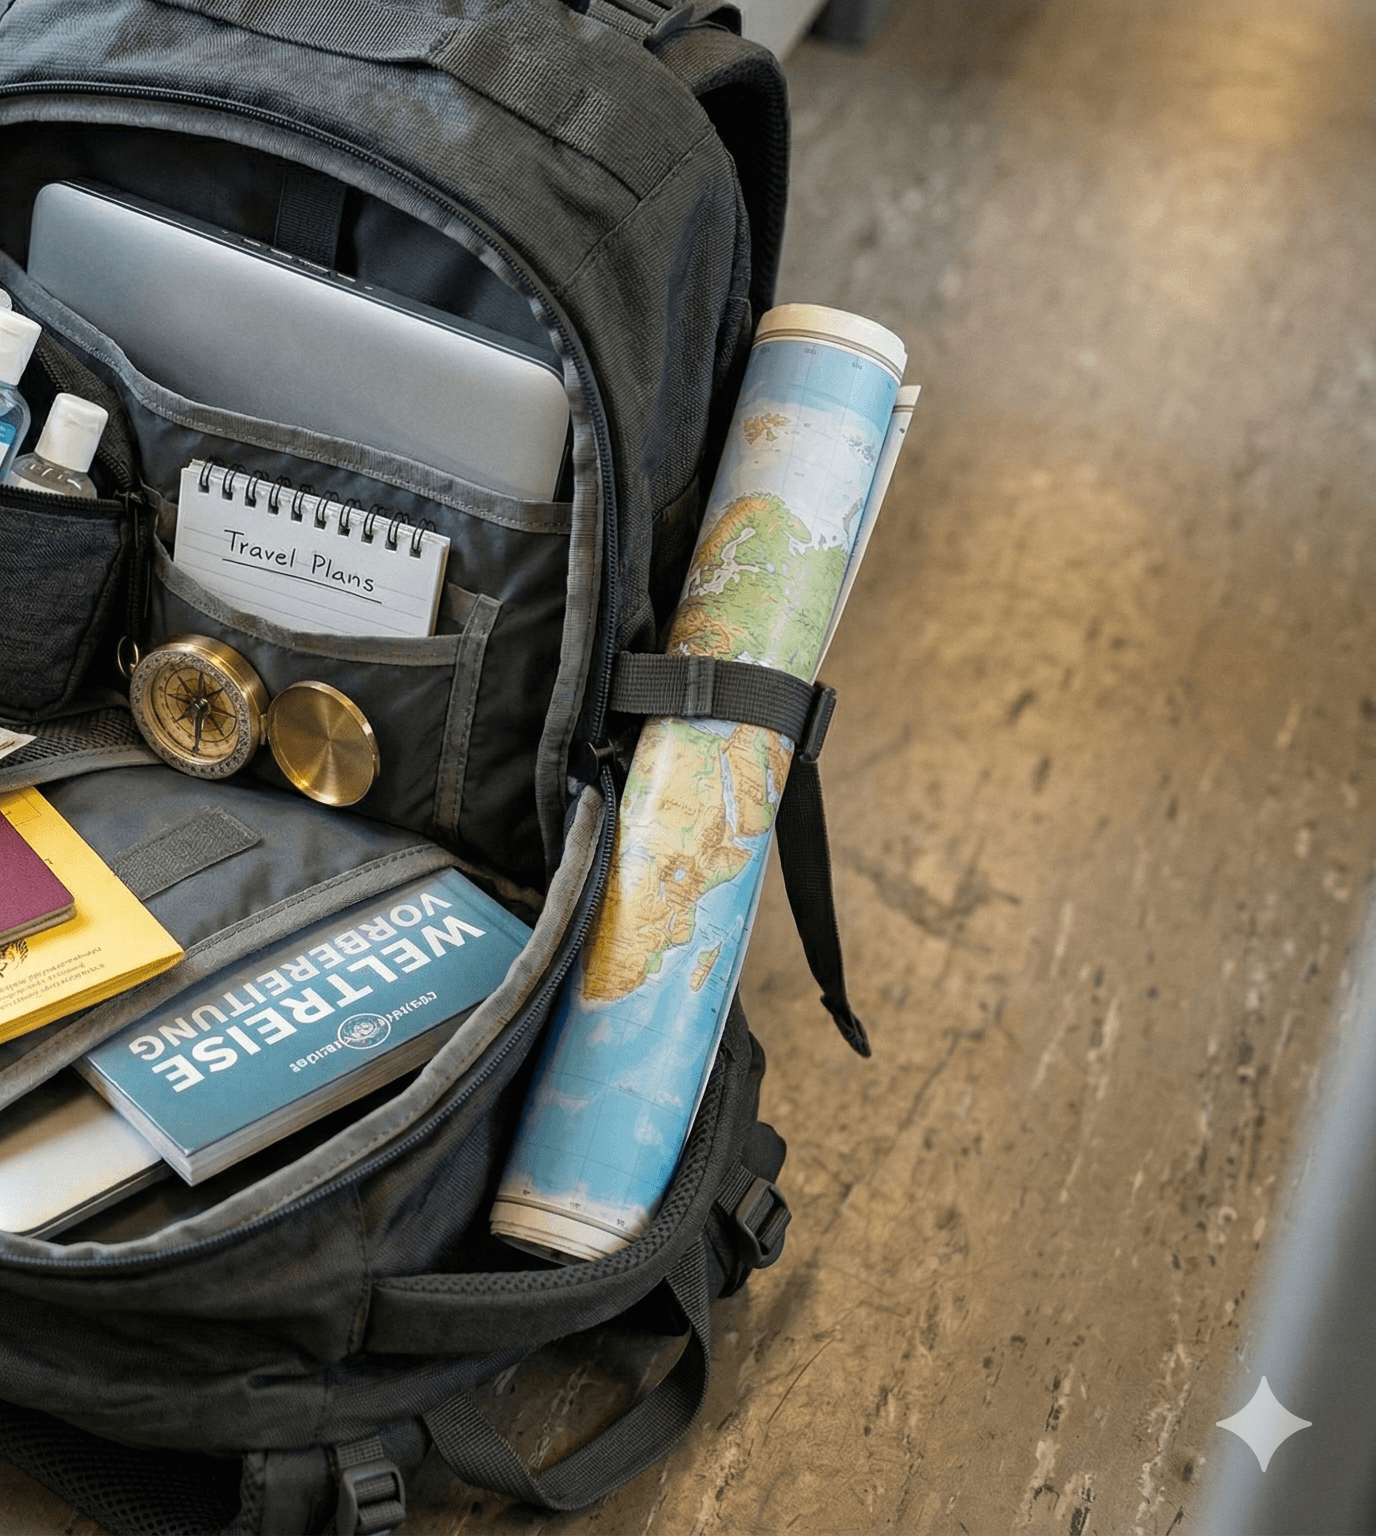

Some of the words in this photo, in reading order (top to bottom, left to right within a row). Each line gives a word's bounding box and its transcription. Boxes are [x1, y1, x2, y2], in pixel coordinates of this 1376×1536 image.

[224, 529, 296, 568] Travel
[311, 554, 374, 592] Plans
[128, 893, 452, 1061] VORBEREITUNG
[151, 913, 488, 1093] WELTREISE
